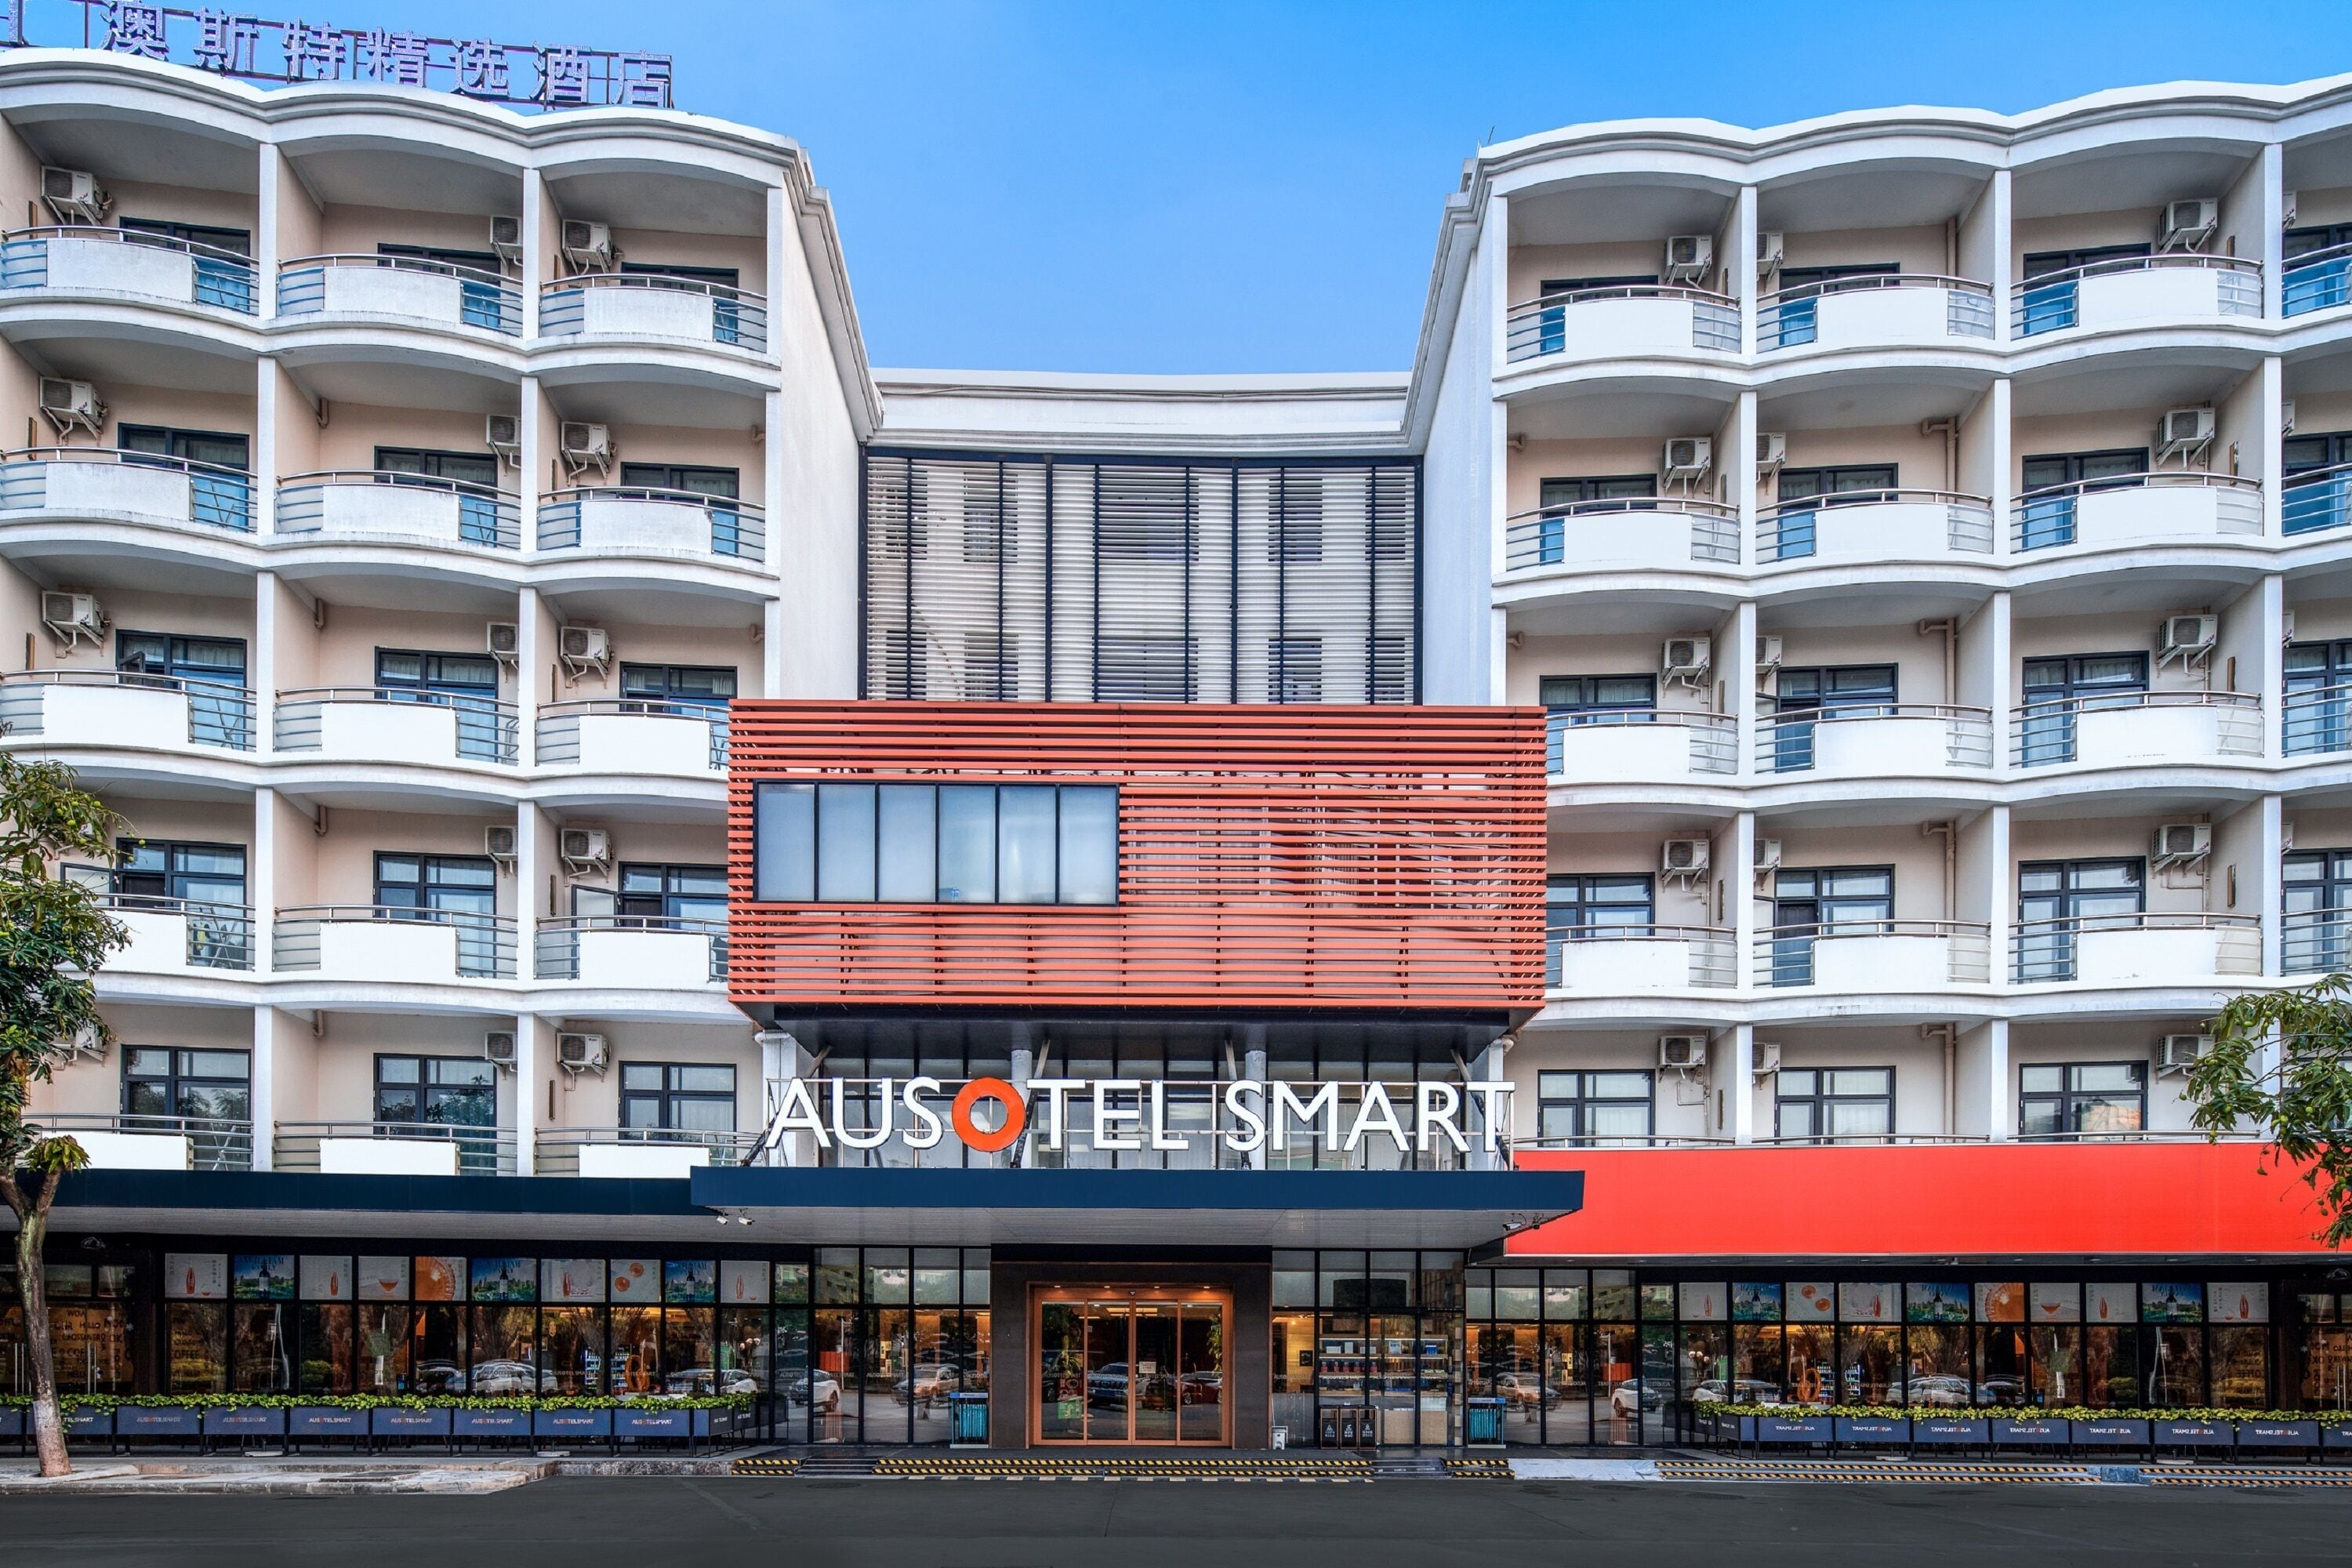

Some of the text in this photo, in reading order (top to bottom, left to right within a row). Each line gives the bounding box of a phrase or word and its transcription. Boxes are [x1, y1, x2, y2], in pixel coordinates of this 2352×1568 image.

[765, 1076, 1516, 1153] AUSOTEL SMART
[243, 1256, 284, 1265] WILIAM
